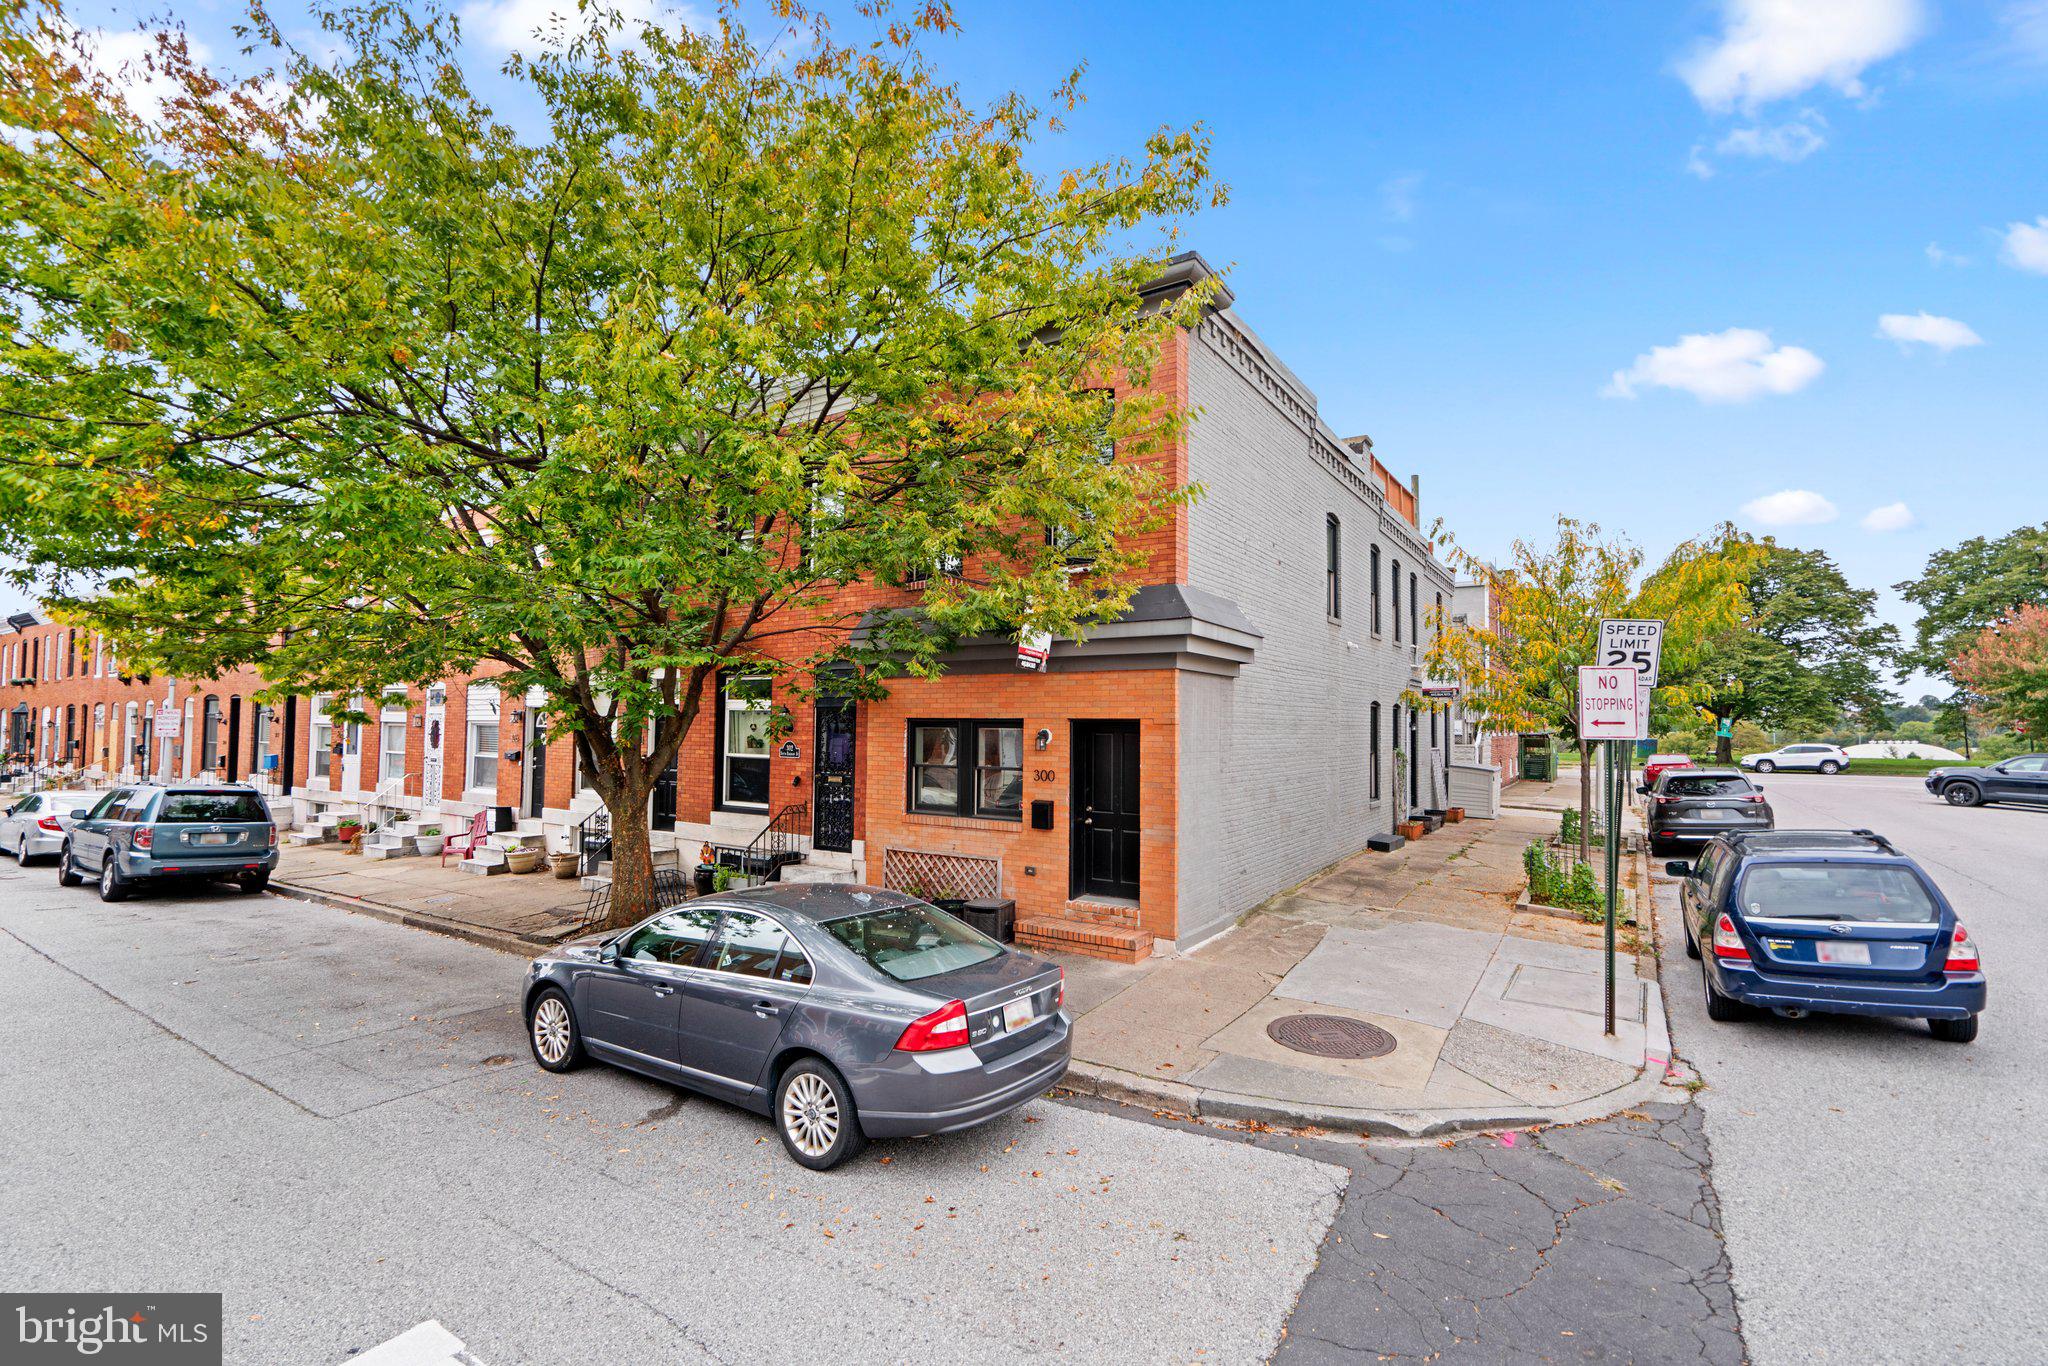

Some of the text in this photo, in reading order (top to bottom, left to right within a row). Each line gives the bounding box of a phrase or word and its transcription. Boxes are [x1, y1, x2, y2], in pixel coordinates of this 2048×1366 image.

[1606, 625, 1657, 635] SPEED
[1610, 639, 1650, 649] LIMIT
[1607, 650, 1651, 674] 25
[1598, 675, 1618, 690] NO
[1585, 697, 1633, 711] STOPPING
[1033, 769, 1056, 782] 300
